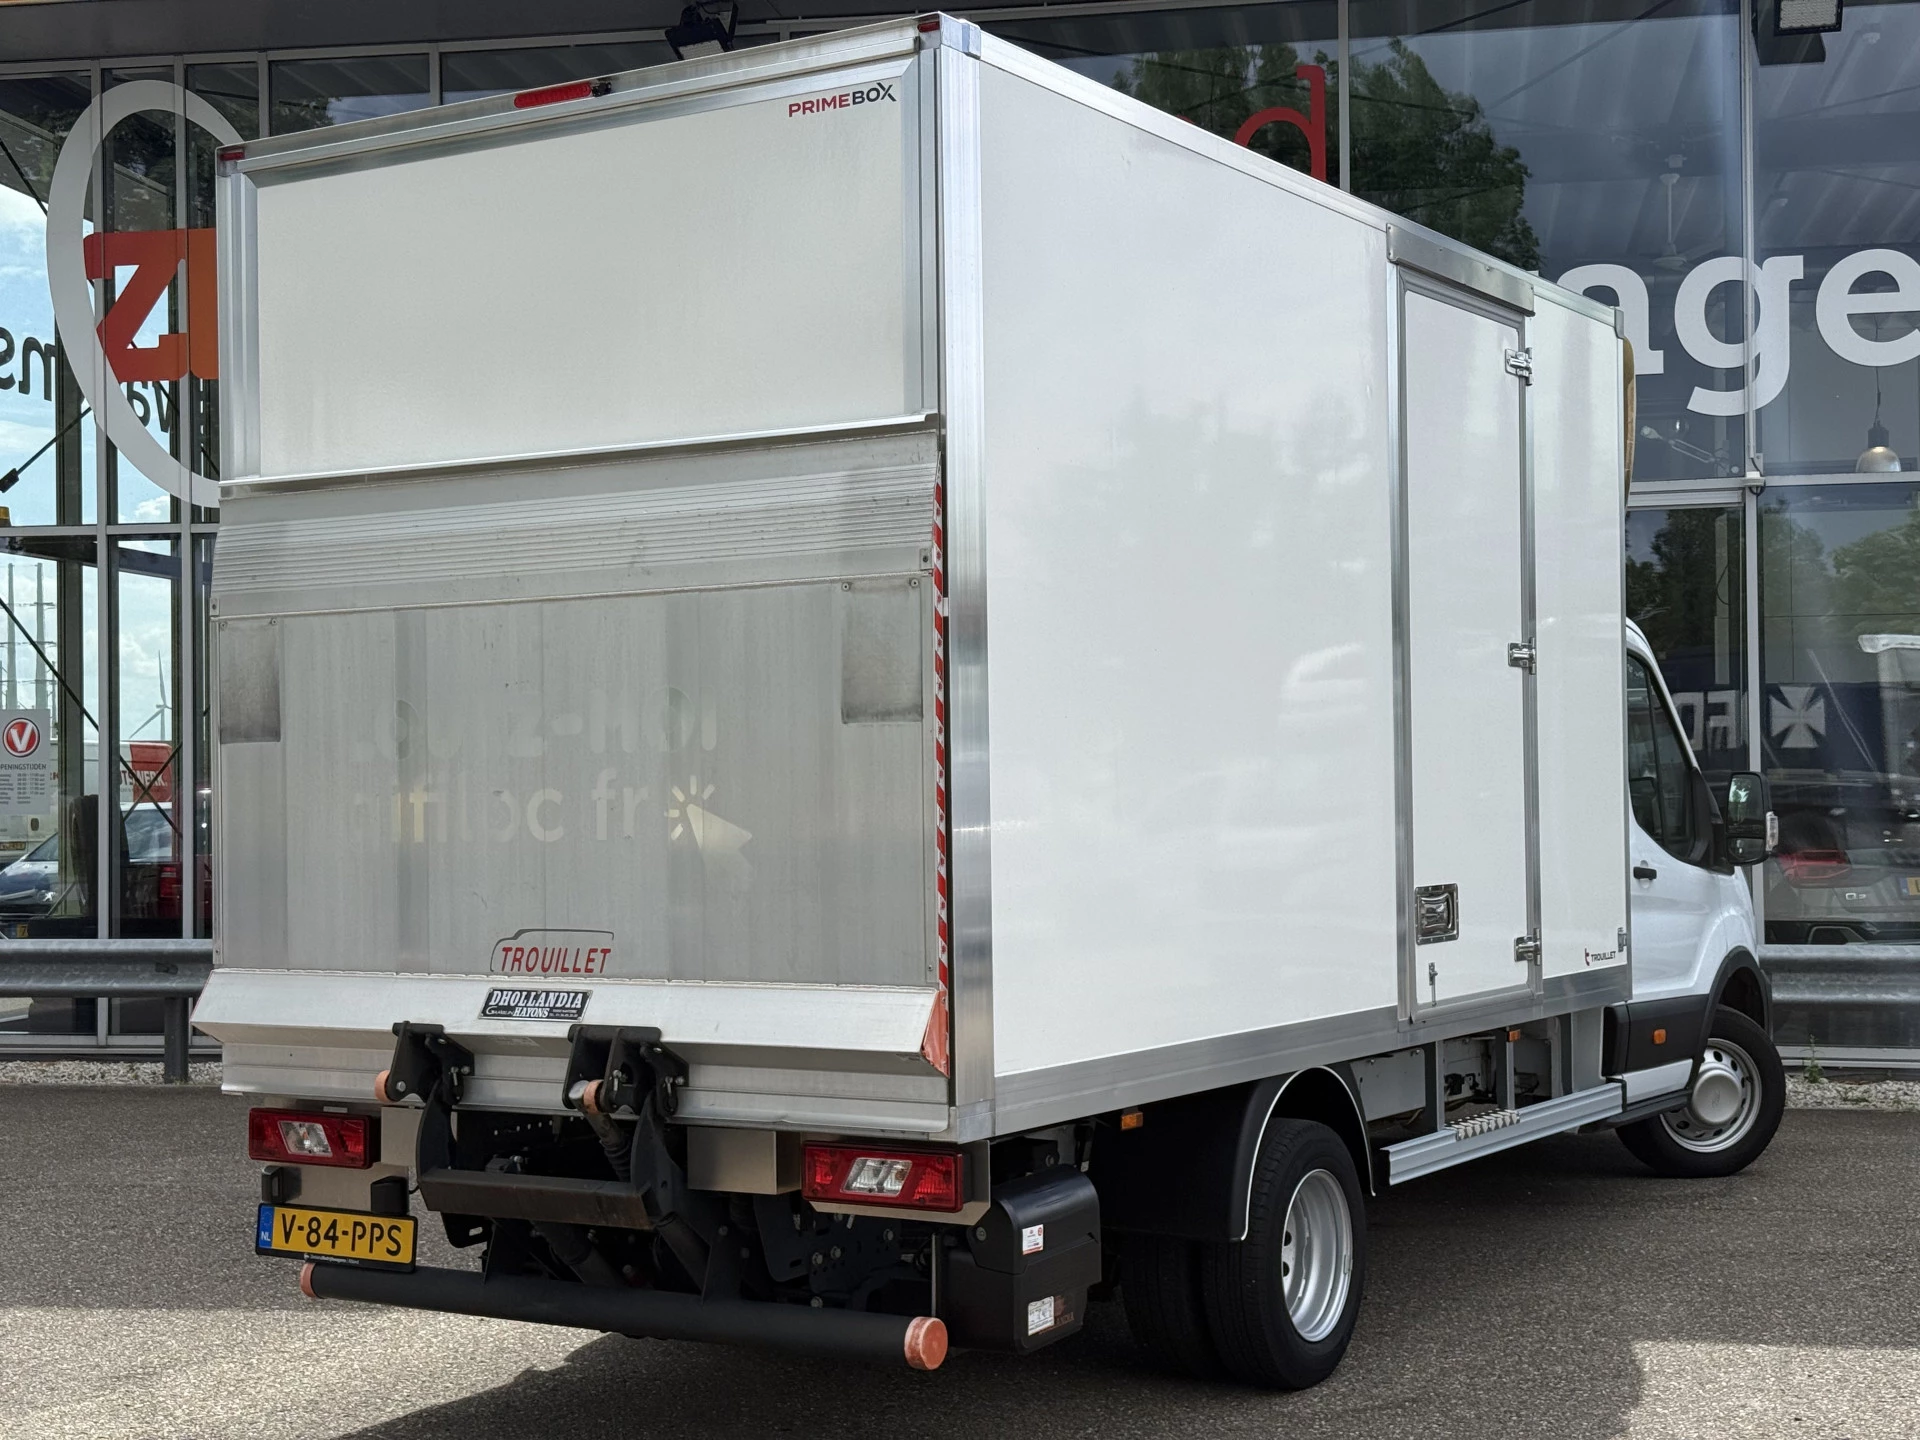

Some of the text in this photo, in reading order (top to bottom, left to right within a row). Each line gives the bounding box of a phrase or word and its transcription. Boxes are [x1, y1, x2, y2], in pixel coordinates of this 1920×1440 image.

[788, 82, 897, 118] PRIMEBOX
[502, 947, 611, 974] TROUILLET
[1591, 951, 1616, 962] TROUILLET
[489, 990, 584, 1008] DHOLLANDIA
[513, 1006, 551, 1018] HAYONS
[260, 1231, 271, 1242] NL
[281, 1213, 402, 1256] V-84-PPS
